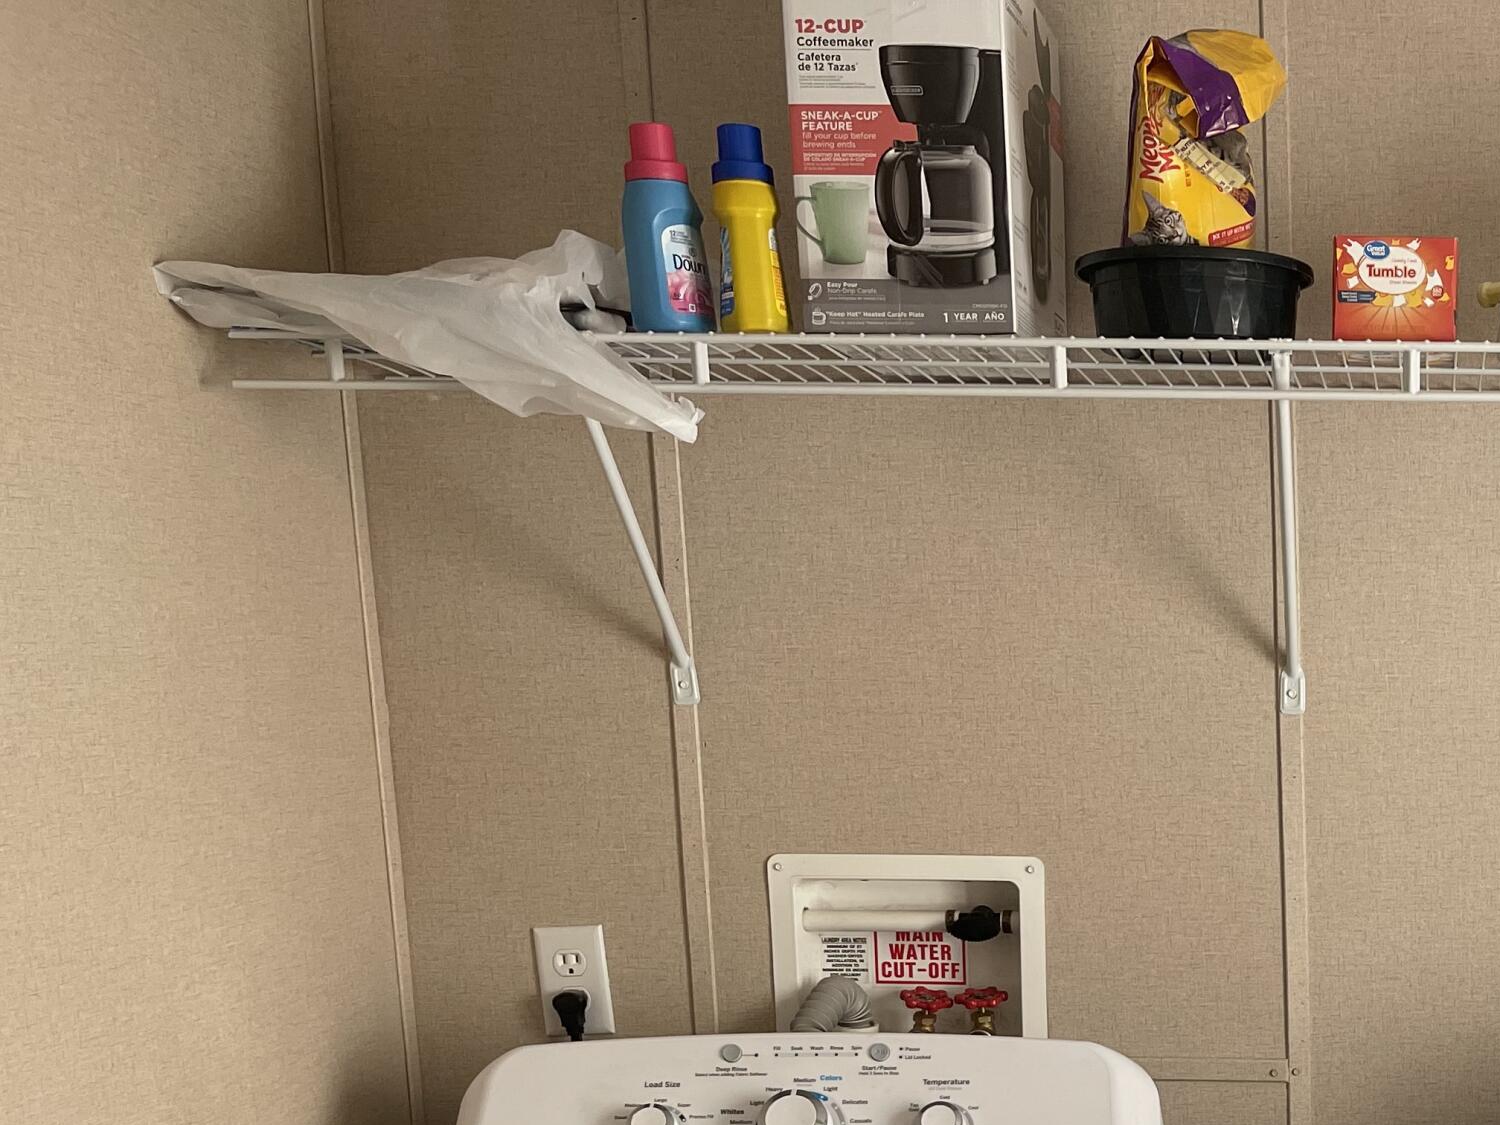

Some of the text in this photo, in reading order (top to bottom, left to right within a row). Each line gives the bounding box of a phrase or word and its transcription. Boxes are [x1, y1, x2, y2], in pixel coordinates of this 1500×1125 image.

[795, 18, 864, 34] 12-CUP
[796, 36, 874, 47] Coffeemaker
[797, 52, 841, 61] Cafetera
[798, 63, 811, 71] de
[814, 62, 825, 71] 12
[800, 110, 879, 120] SNEAK-A-CUP
[801, 121, 853, 131] FEATURE
[814, 133, 831, 141] your
[850, 132, 877, 140] before
[802, 141, 835, 149] brewing
[1366, 264, 1416, 278] Tumble
[943, 311, 1005, 323] 1 YEAR AÑO
[889, 944, 952, 960] WATER
[881, 962, 960, 978] CUT-OFF
